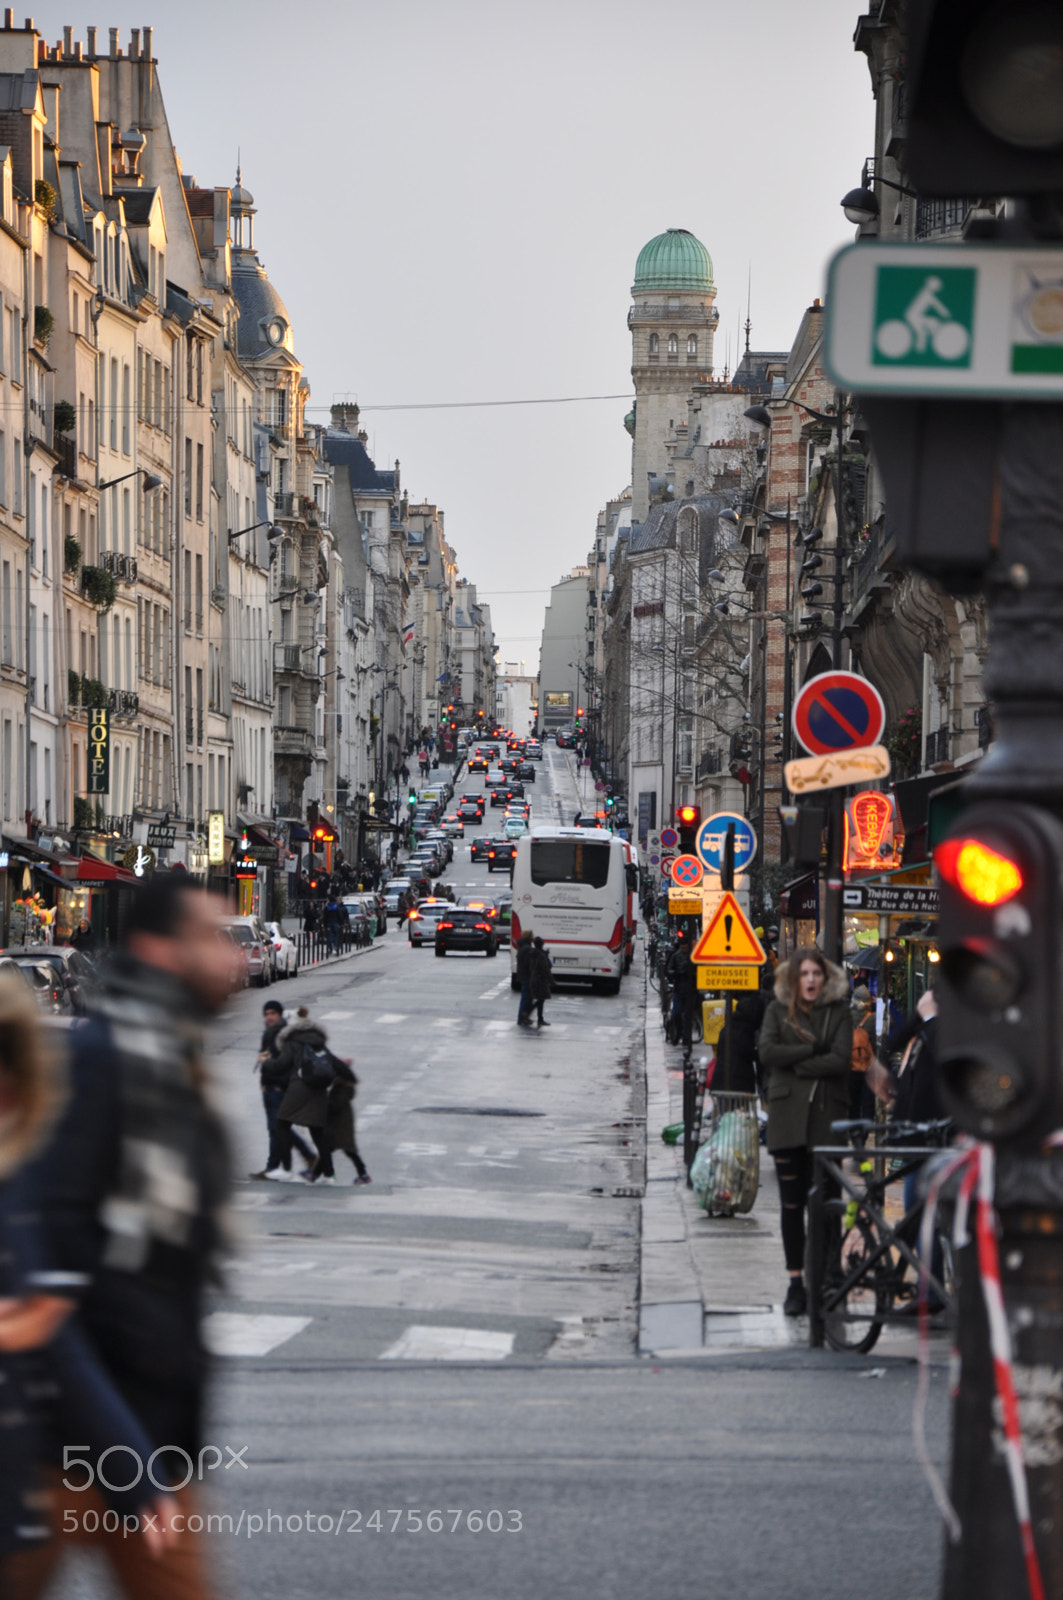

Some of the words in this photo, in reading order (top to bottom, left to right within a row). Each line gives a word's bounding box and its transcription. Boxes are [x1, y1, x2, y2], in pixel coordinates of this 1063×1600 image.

[91, 708, 107, 792] HOTEL
[148, 826, 175, 837] JEUX
[866, 804, 878, 848] KEBAB
[868, 888, 899, 899] Théâtre
[903, 891, 914, 900] de
[917, 891, 926, 901] la
[881, 900, 896, 909] Rue
[911, 902, 919, 910] la
[706, 969, 749, 977] CHAUSSEE
[706, 978, 749, 986] DEFORMEE
